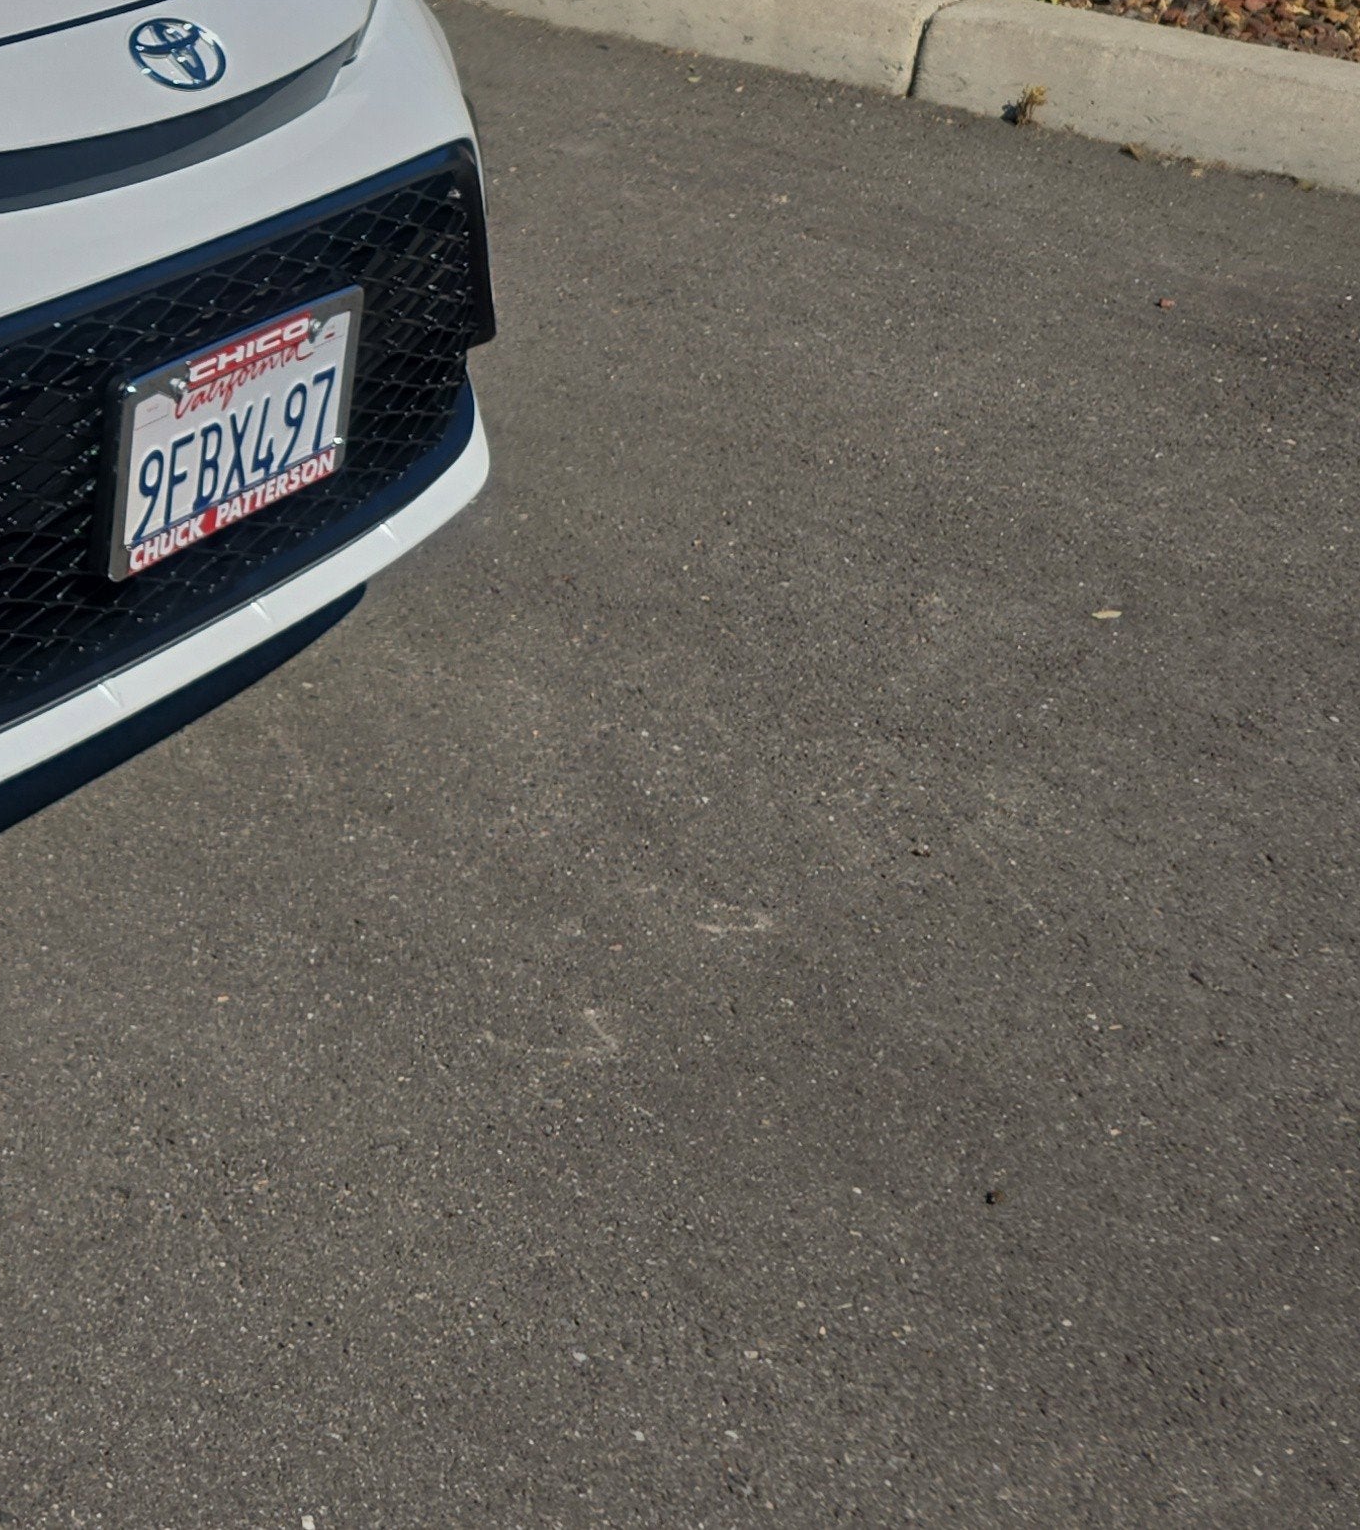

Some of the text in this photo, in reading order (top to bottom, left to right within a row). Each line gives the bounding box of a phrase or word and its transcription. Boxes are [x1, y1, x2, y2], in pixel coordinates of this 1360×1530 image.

[189, 317, 310, 382] CHICO
[130, 450, 335, 570] CHUCK PATTERSON
[132, 366, 336, 542] 9FBX497
